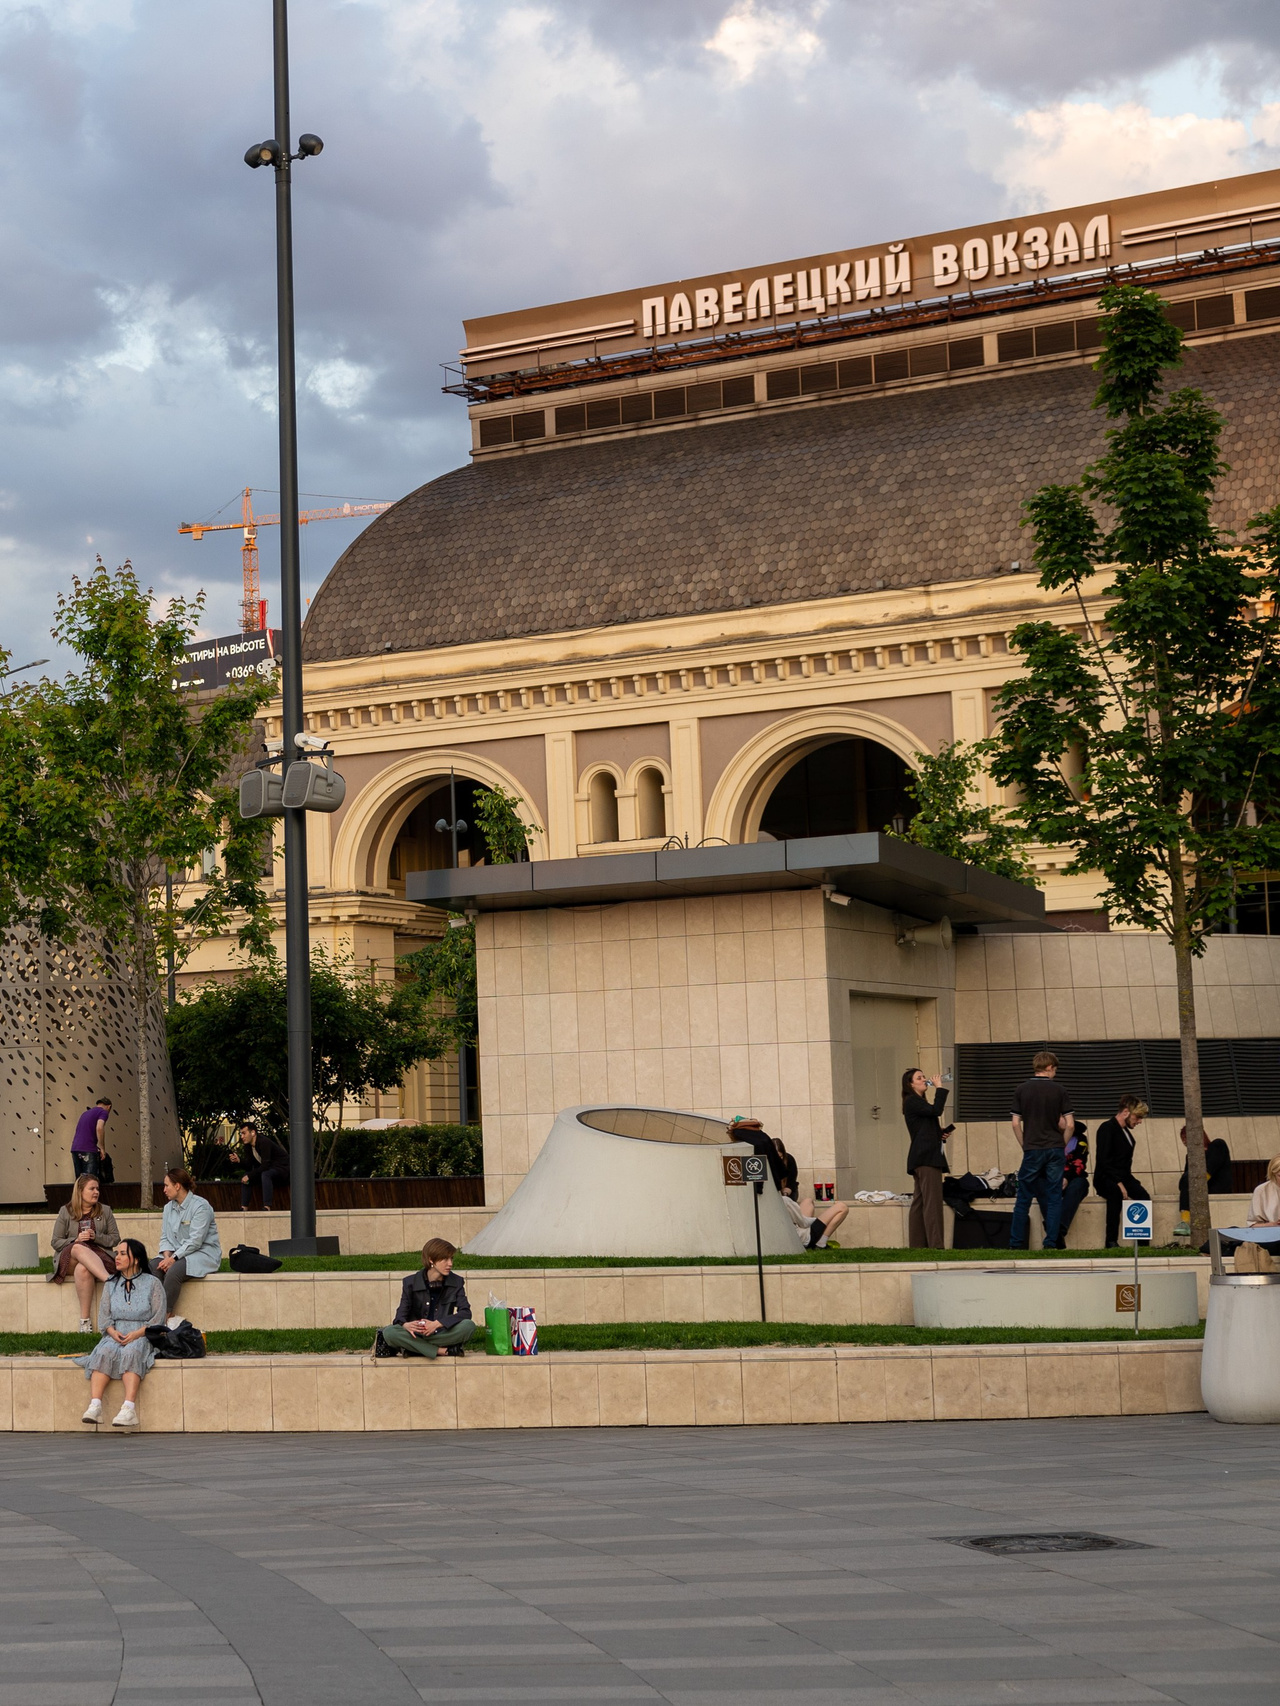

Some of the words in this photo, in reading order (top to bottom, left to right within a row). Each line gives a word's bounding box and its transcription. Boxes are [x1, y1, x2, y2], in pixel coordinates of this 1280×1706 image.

[641, 243, 911, 338] ПАВЕЛЕЦКИЙ
[932, 214, 1111, 288] ВОКЗАЛ
[217, 645, 229, 657] НА
[230, 638, 265, 654] ВЫСОТЕ
